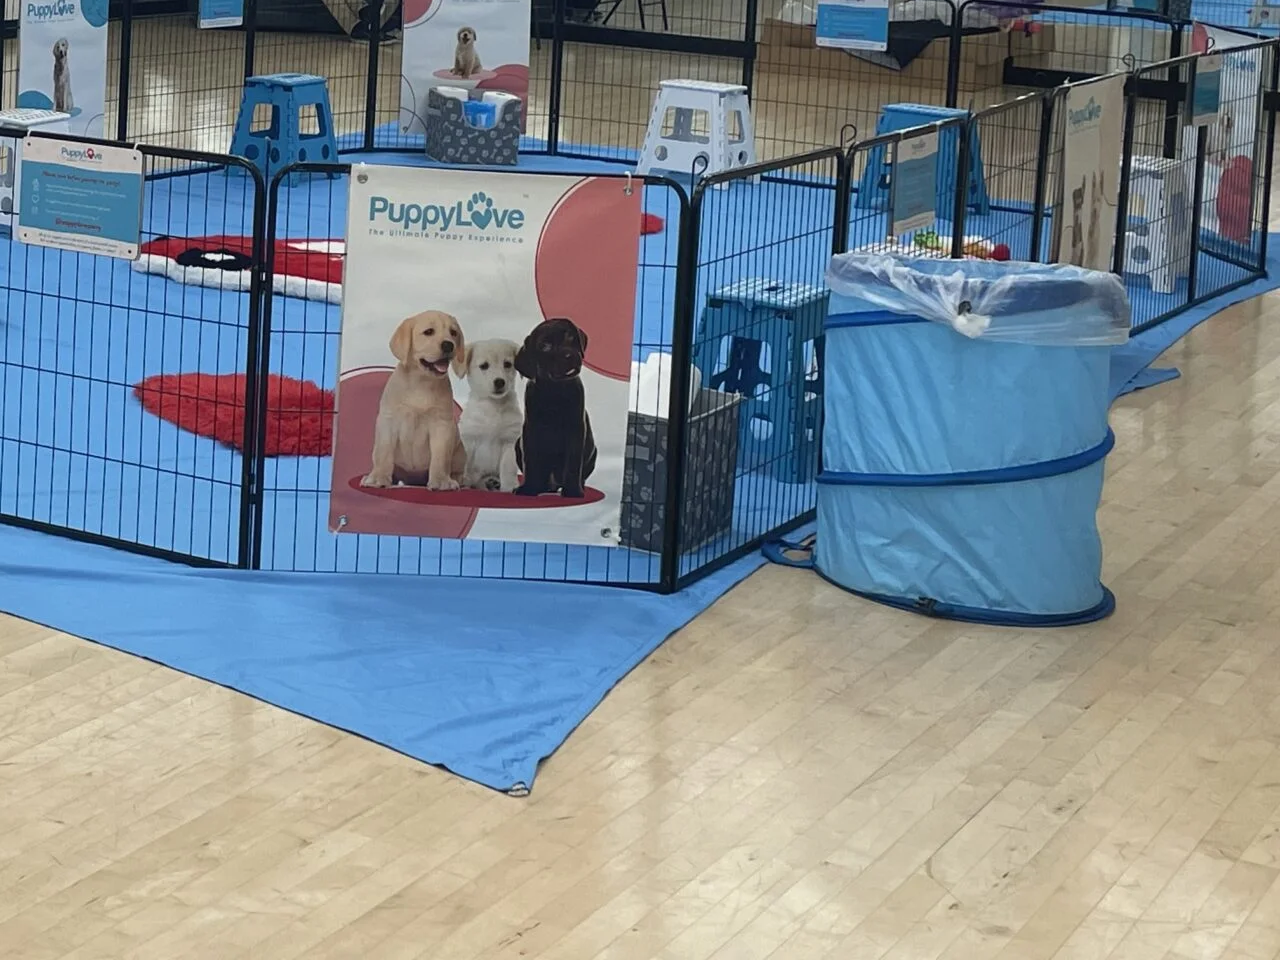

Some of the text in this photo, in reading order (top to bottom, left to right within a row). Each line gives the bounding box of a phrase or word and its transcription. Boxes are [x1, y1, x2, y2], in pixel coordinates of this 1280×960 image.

[369, 191, 525, 232] PuppyLove
[369, 228, 384, 236] The
[434, 232, 464, 241] Puppy
[468, 234, 524, 244] Experience
